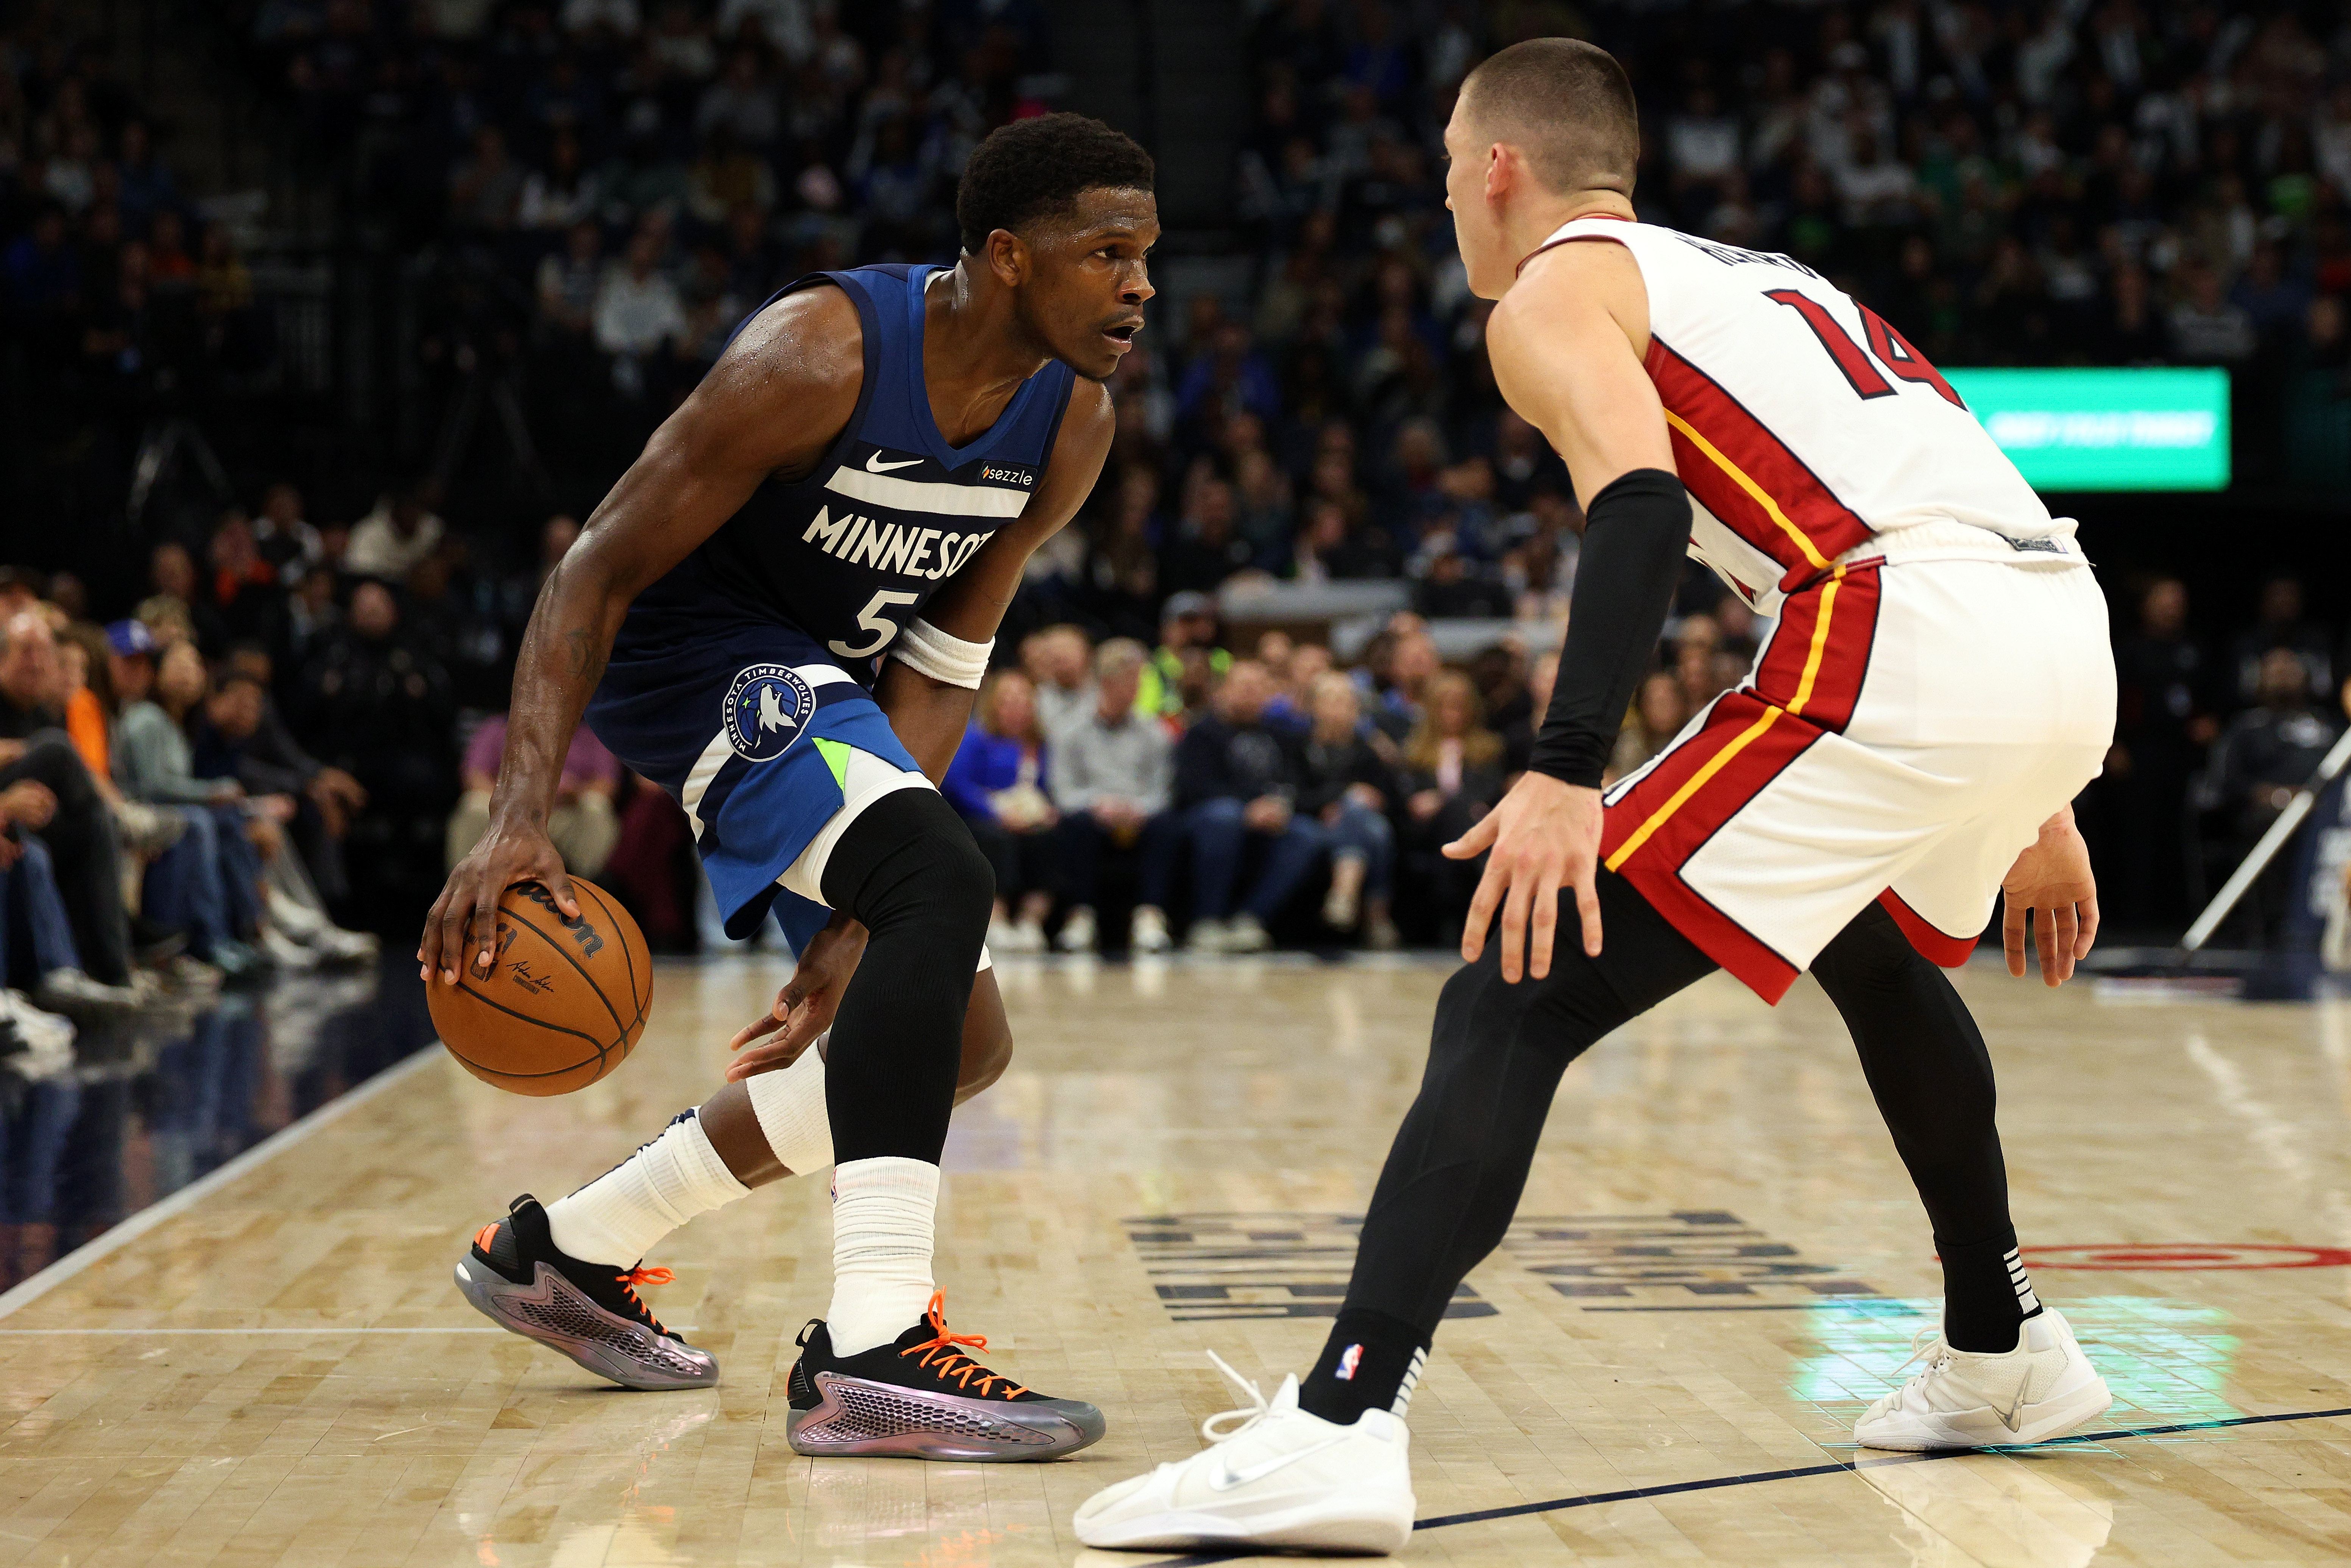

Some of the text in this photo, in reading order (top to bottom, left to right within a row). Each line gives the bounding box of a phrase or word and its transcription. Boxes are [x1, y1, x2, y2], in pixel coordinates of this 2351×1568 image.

[1760, 288, 1970, 413] 14
[989, 469, 1033, 485] sezzle
[828, 589, 920, 658] 5
[726, 668, 811, 752] MINNESOTA TIMBERWOLVES
